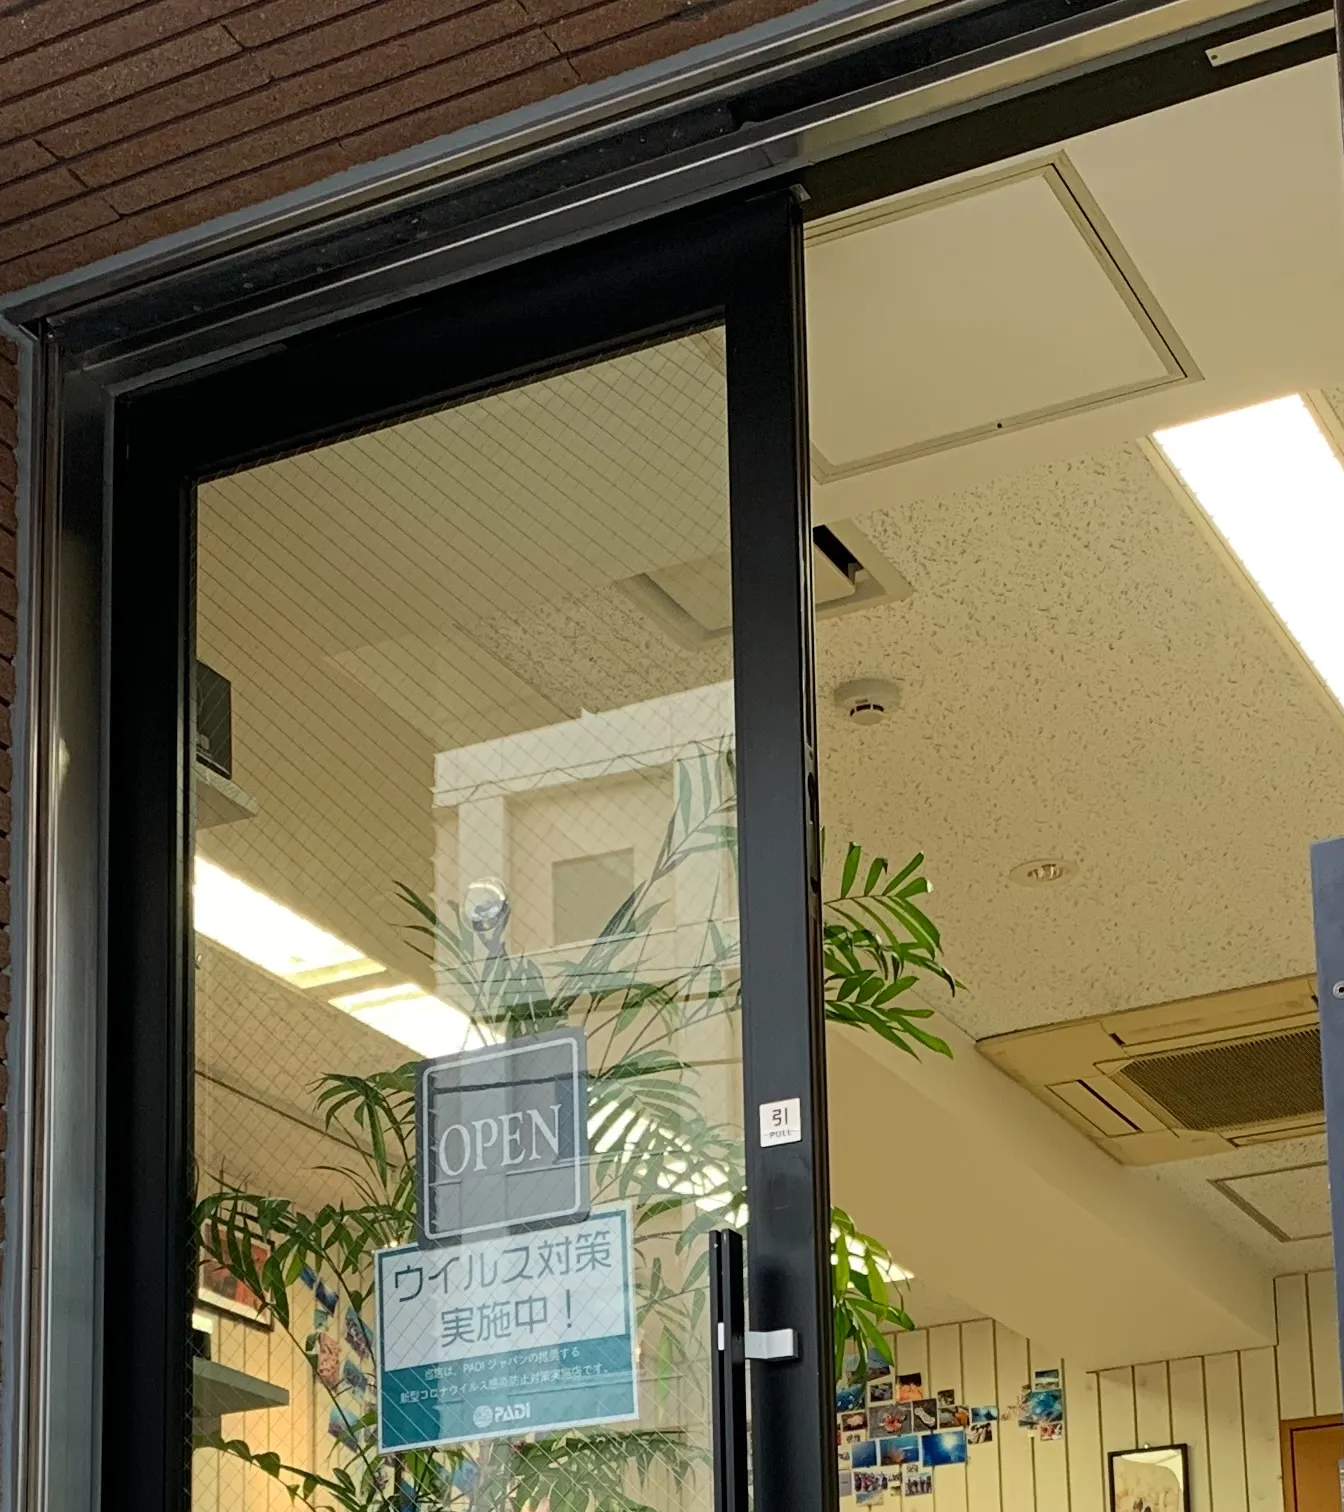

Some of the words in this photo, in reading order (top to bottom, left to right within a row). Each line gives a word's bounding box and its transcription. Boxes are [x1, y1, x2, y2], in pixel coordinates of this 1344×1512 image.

[771, 1107, 788, 1127] 引
[438, 1103, 562, 1177] OPEN
[769, 1129, 792, 1139] PULL
[394, 1230, 613, 1302] ウイルス対策
[495, 1402, 532, 1423] PADI
